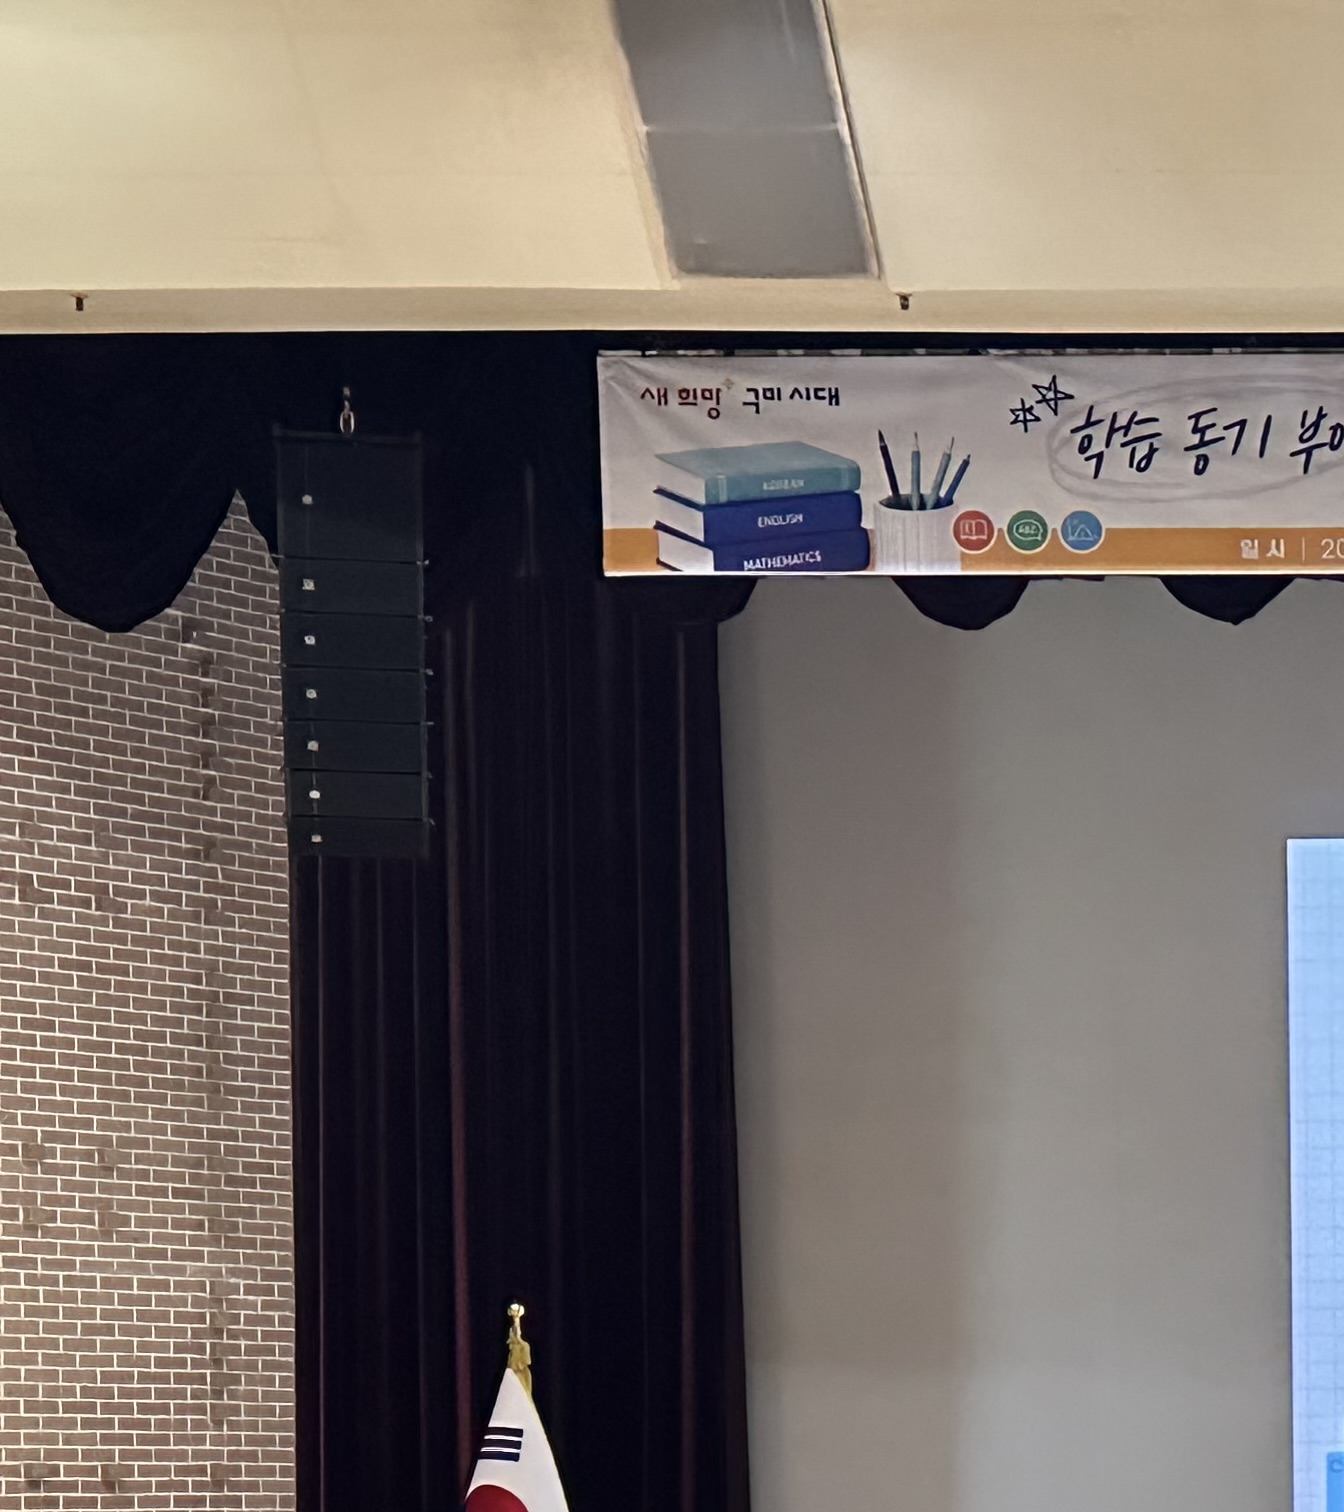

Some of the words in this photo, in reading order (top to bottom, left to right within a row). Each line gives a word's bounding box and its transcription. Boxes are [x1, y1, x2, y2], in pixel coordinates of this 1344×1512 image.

[1071, 405, 1163, 479] 학습
[1184, 407, 1271, 476] 동기
[757, 513, 804, 529] ENGLISH
[743, 549, 823, 572] MATHEMATICS
